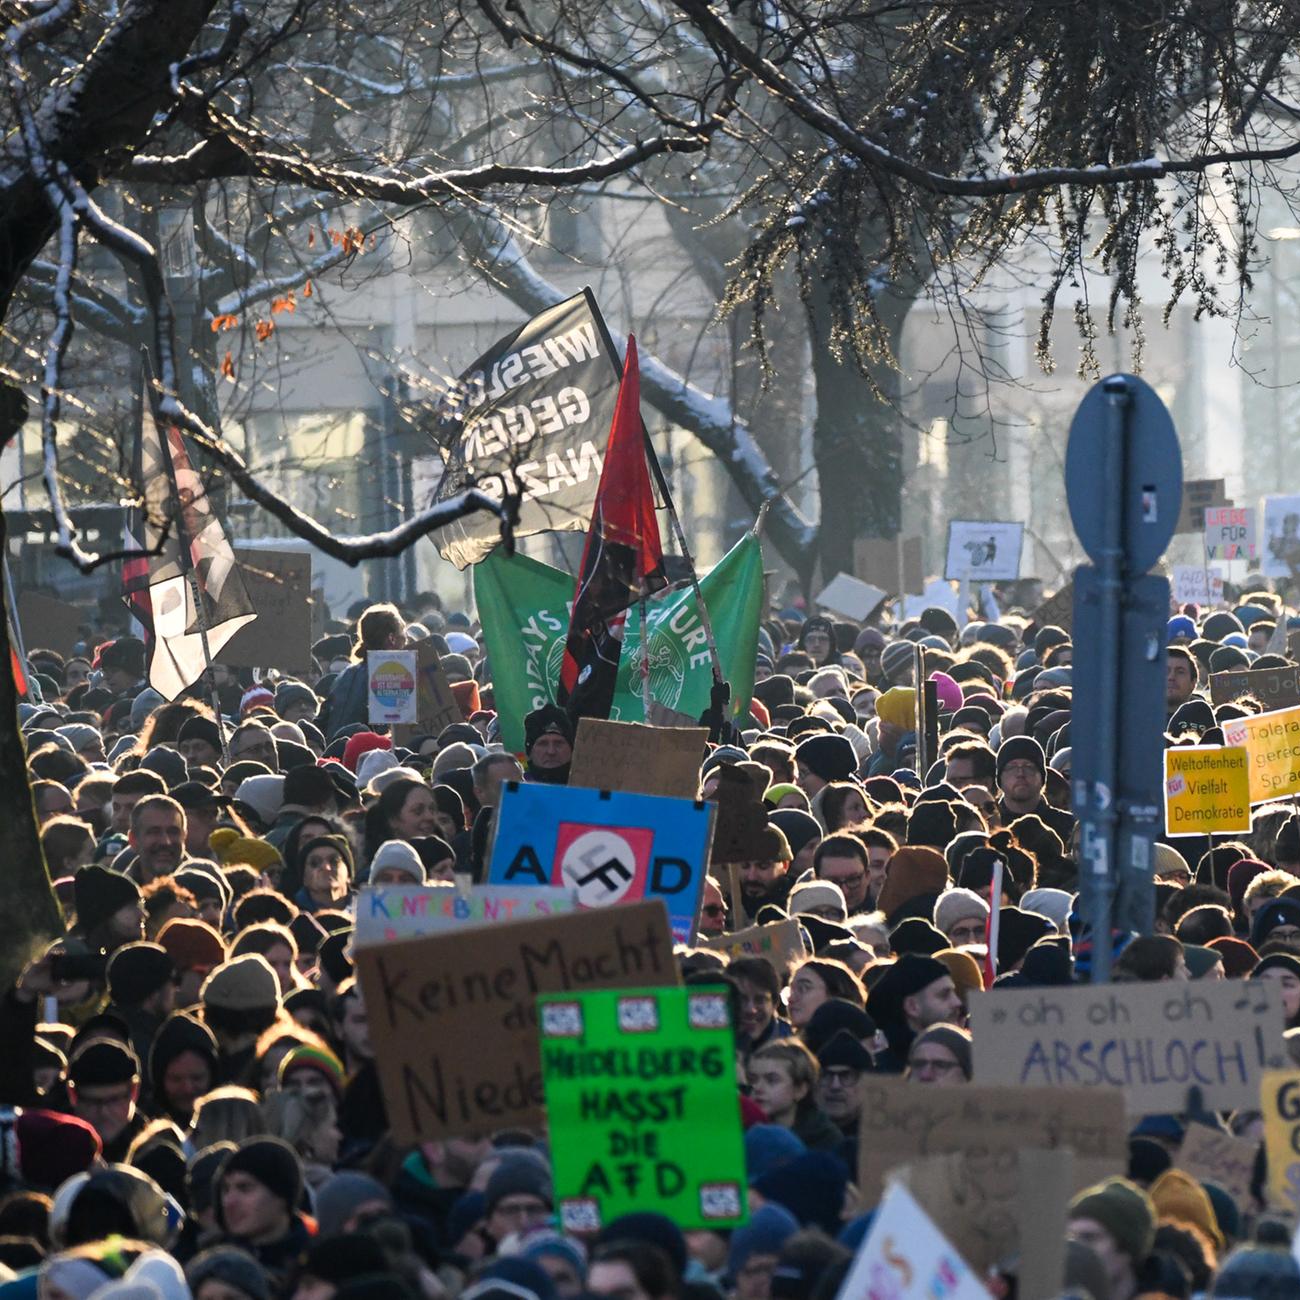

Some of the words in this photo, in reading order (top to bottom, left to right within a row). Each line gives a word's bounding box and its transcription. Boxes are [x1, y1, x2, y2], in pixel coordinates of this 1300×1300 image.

[1208, 508, 1249, 526] LIEBE
[1227, 728, 1247, 746] für
[1170, 755, 1244, 771] Weltoffenheit
[1168, 778, 1185, 795] für
[1188, 778, 1227, 795] Vielfalt
[1174, 806, 1244, 822] Demokratie
[376, 956, 515, 1029] Keine
[518, 925, 662, 992] Macht
[1018, 998, 1063, 1026] oh
[1087, 998, 1130, 1025] oh
[1163, 989, 1212, 1021] oh
[545, 1044, 724, 1081] HEIDELBERG
[402, 1054, 544, 1135] Niede
[579, 1086, 687, 1123] HASST
[609, 1131, 657, 1158] DIE
